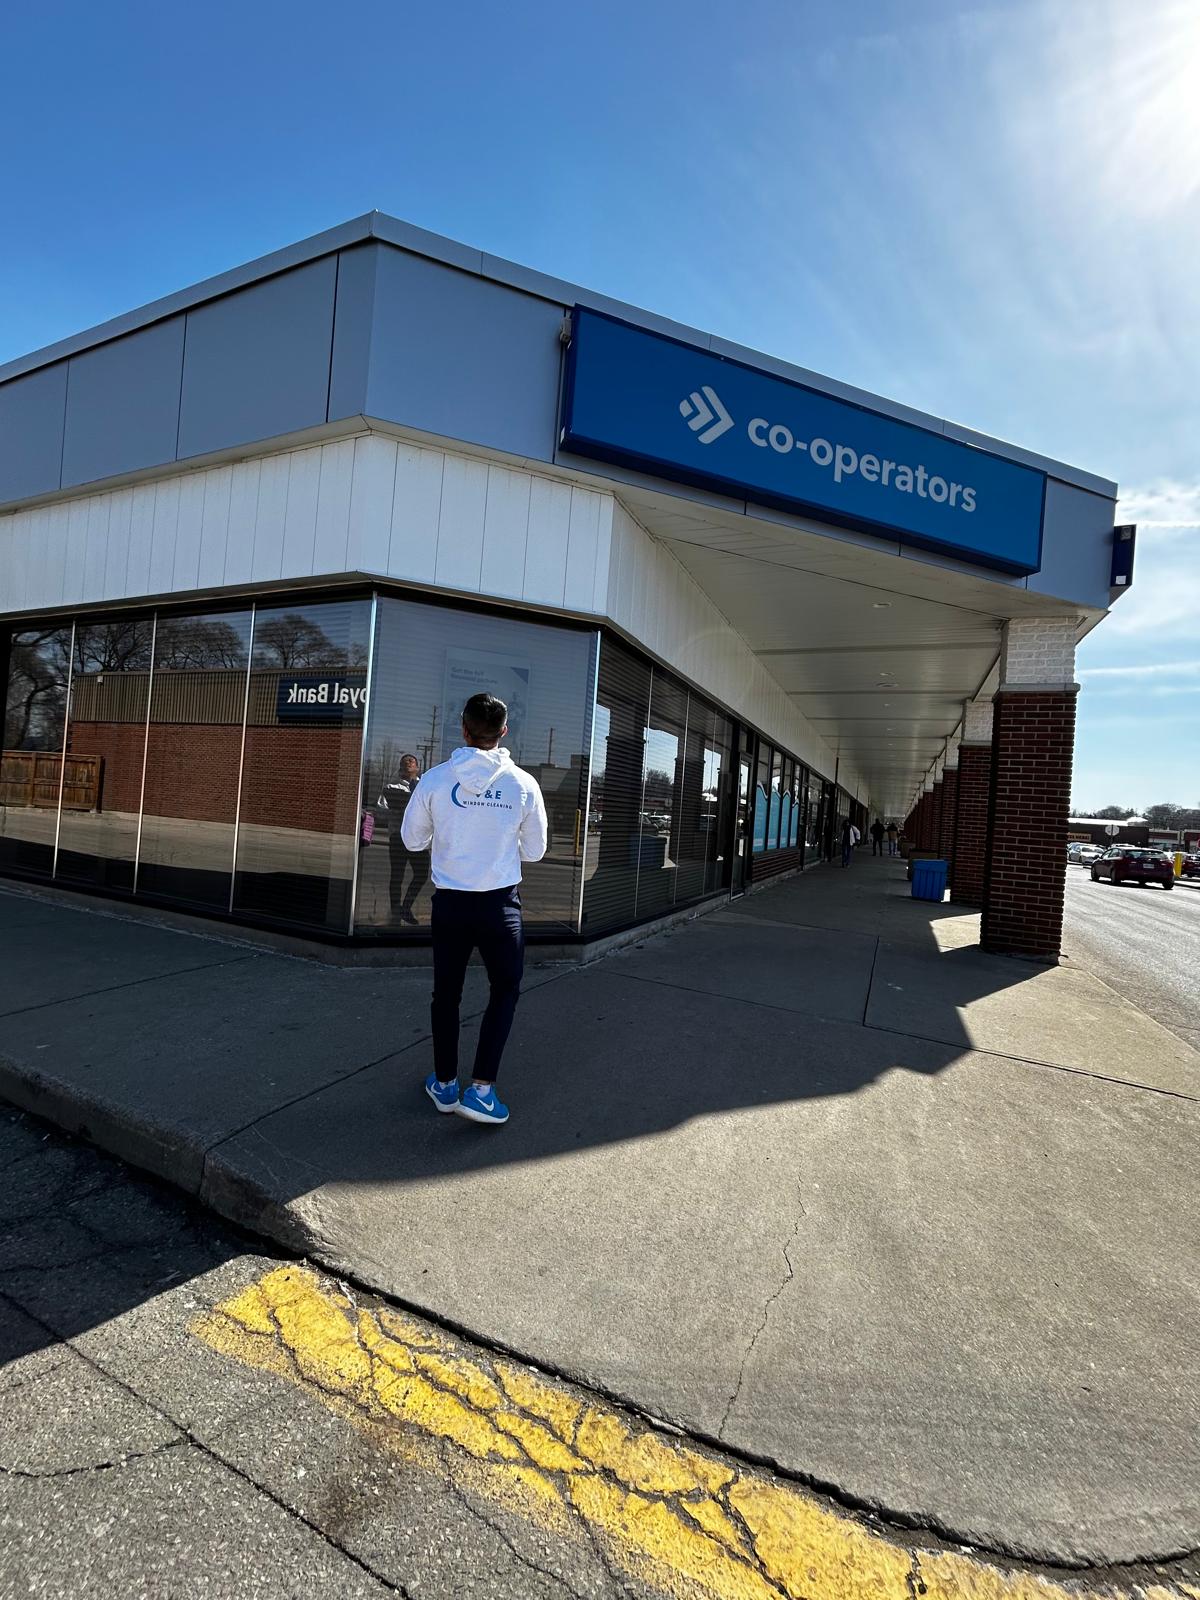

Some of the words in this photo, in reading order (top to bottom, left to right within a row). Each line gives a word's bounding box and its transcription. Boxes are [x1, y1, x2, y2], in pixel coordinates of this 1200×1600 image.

[747, 417, 977, 513] co-operators
[484, 790, 493, 799] &
[495, 791, 502, 799] E
